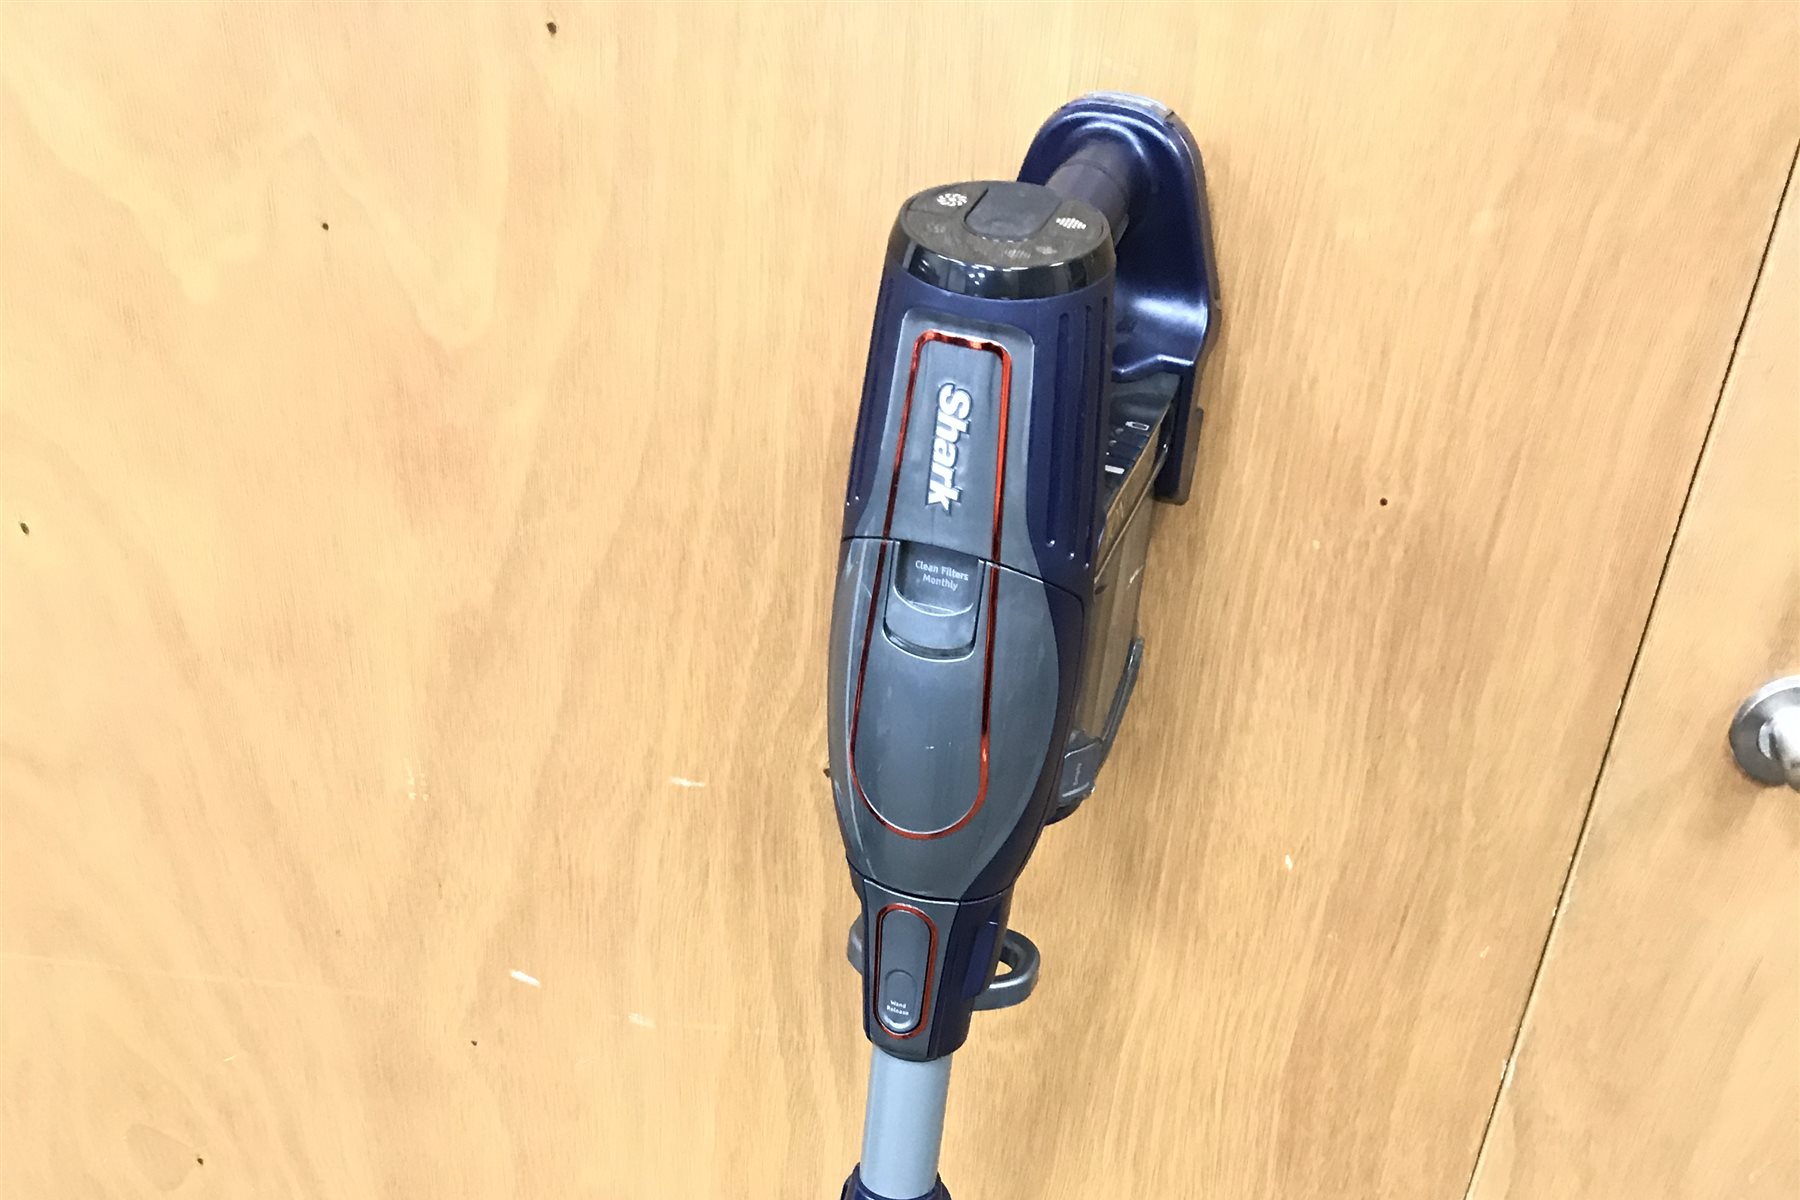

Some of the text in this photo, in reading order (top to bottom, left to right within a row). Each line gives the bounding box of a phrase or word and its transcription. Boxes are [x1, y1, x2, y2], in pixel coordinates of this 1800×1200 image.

[926, 382, 972, 513] Shark
[915, 560, 969, 581] Clean Filters
[922, 573, 958, 592] Monthly
